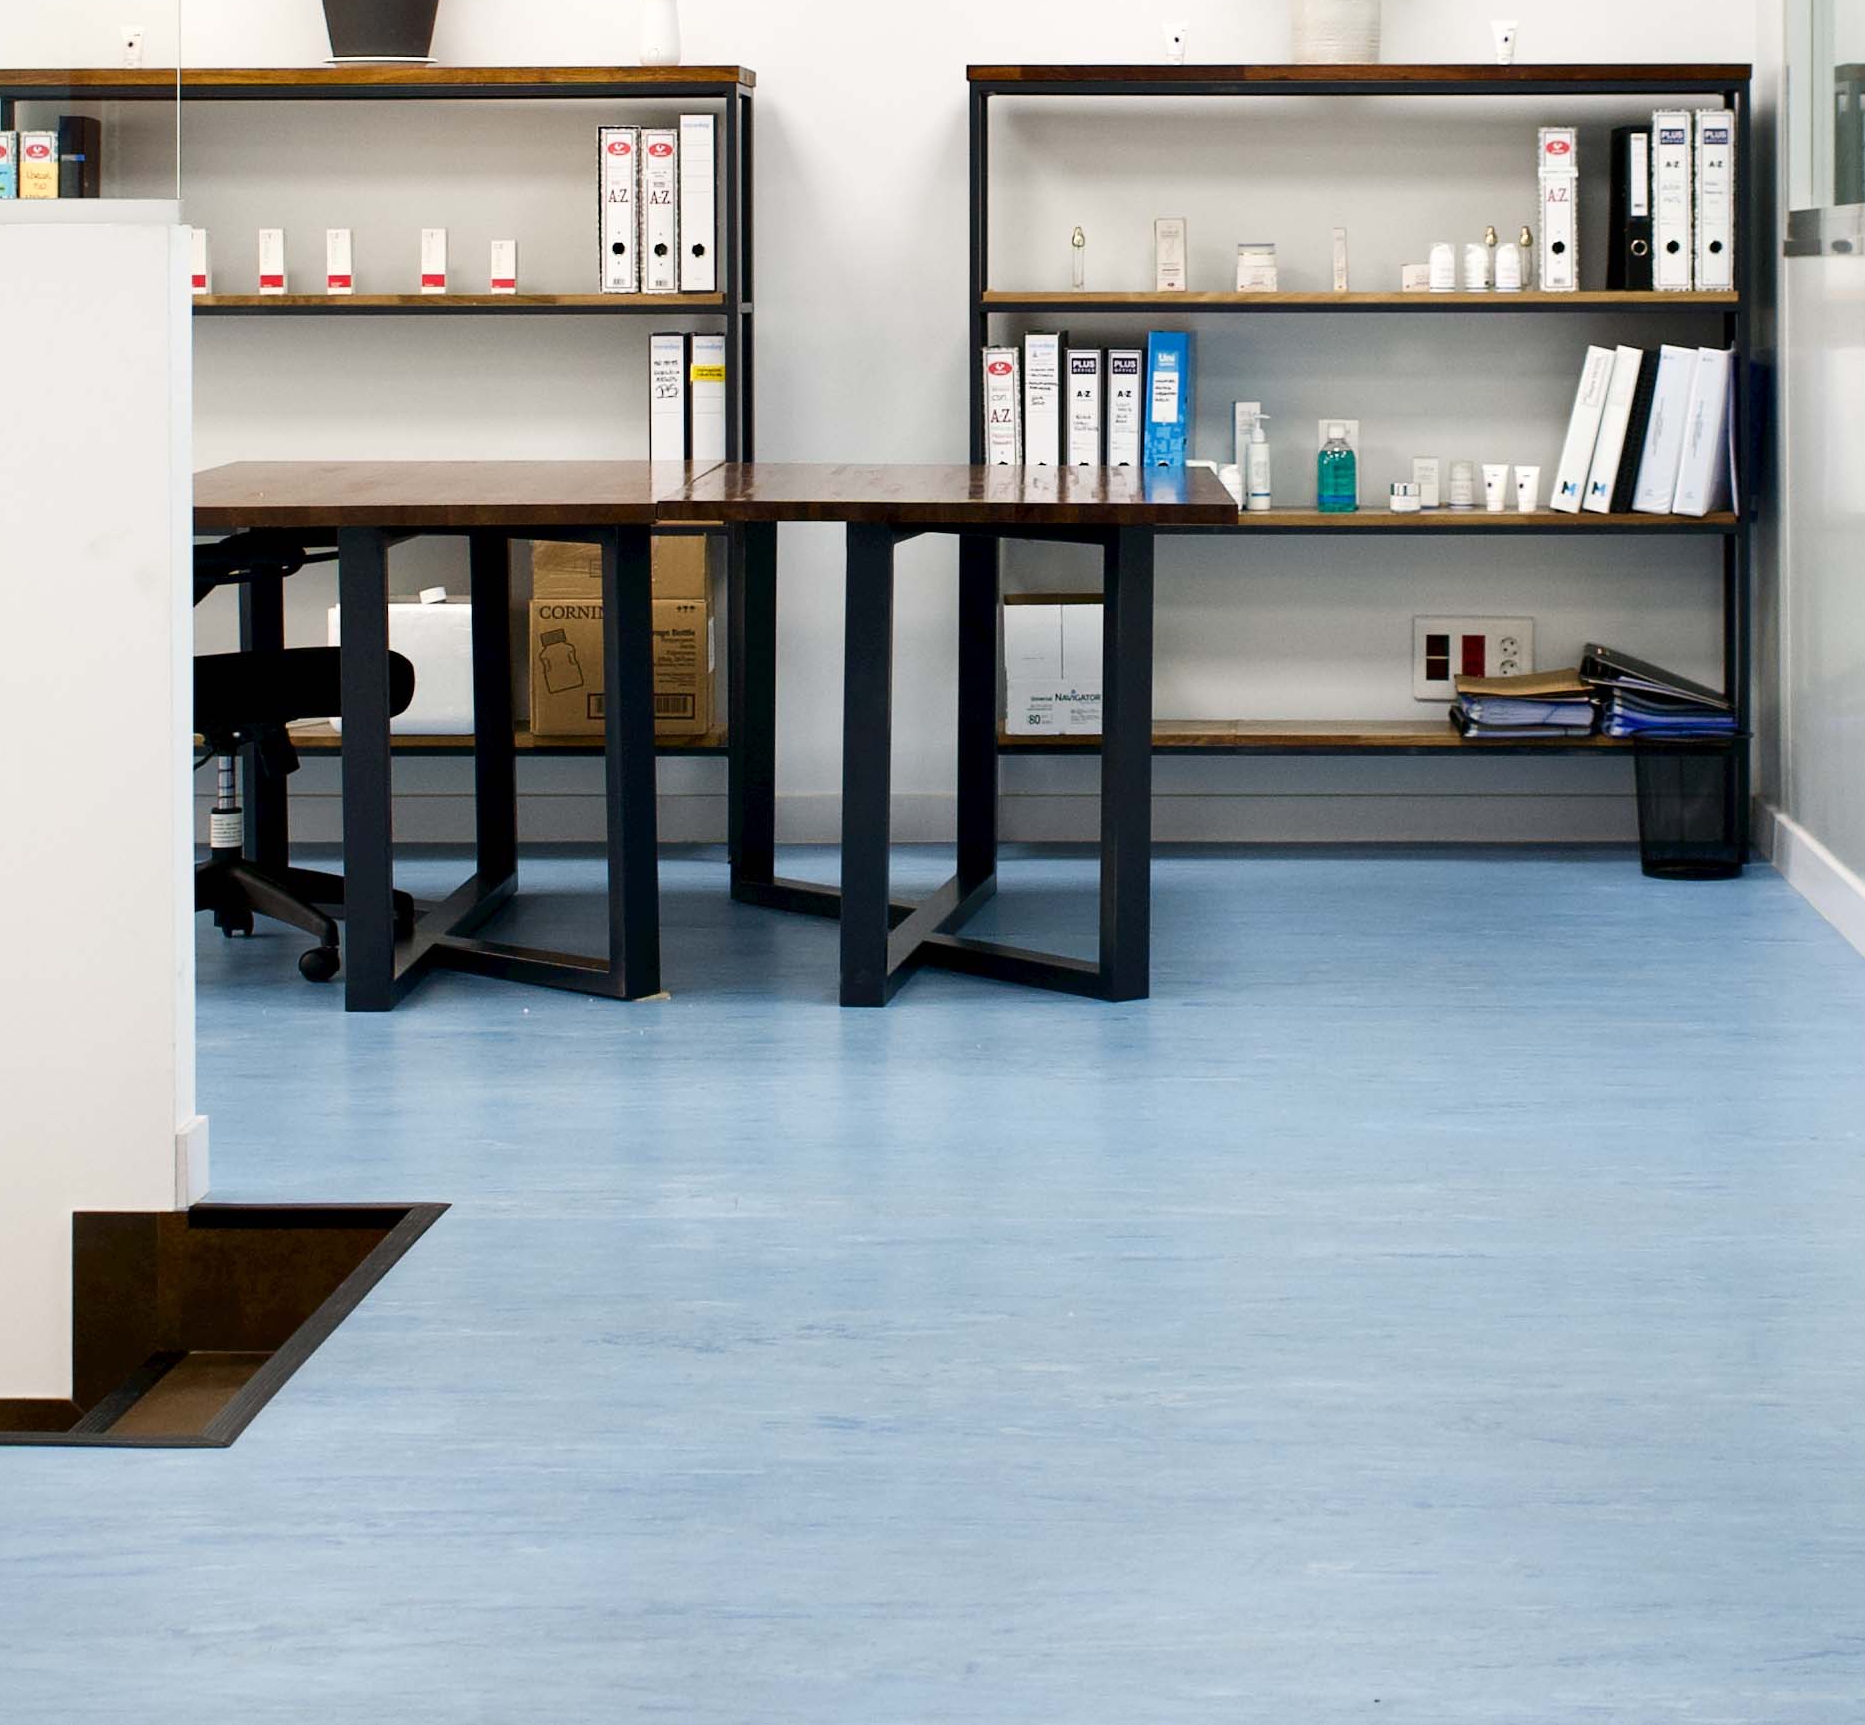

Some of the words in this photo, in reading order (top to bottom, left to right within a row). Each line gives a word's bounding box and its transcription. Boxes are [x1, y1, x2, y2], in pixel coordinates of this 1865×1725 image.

[608, 189, 629, 203] A-Z
[649, 190, 671, 205] A-Z
[1547, 187, 1570, 202] A-Z
[1073, 360, 1095, 368] PLUS
[1114, 360, 1136, 368] PLUS
[1077, 390, 1091, 398] A-Z
[1118, 390, 1132, 398] A-Z
[990, 408, 1012, 423] A-Z
[1028, 714, 1041, 725] 80
